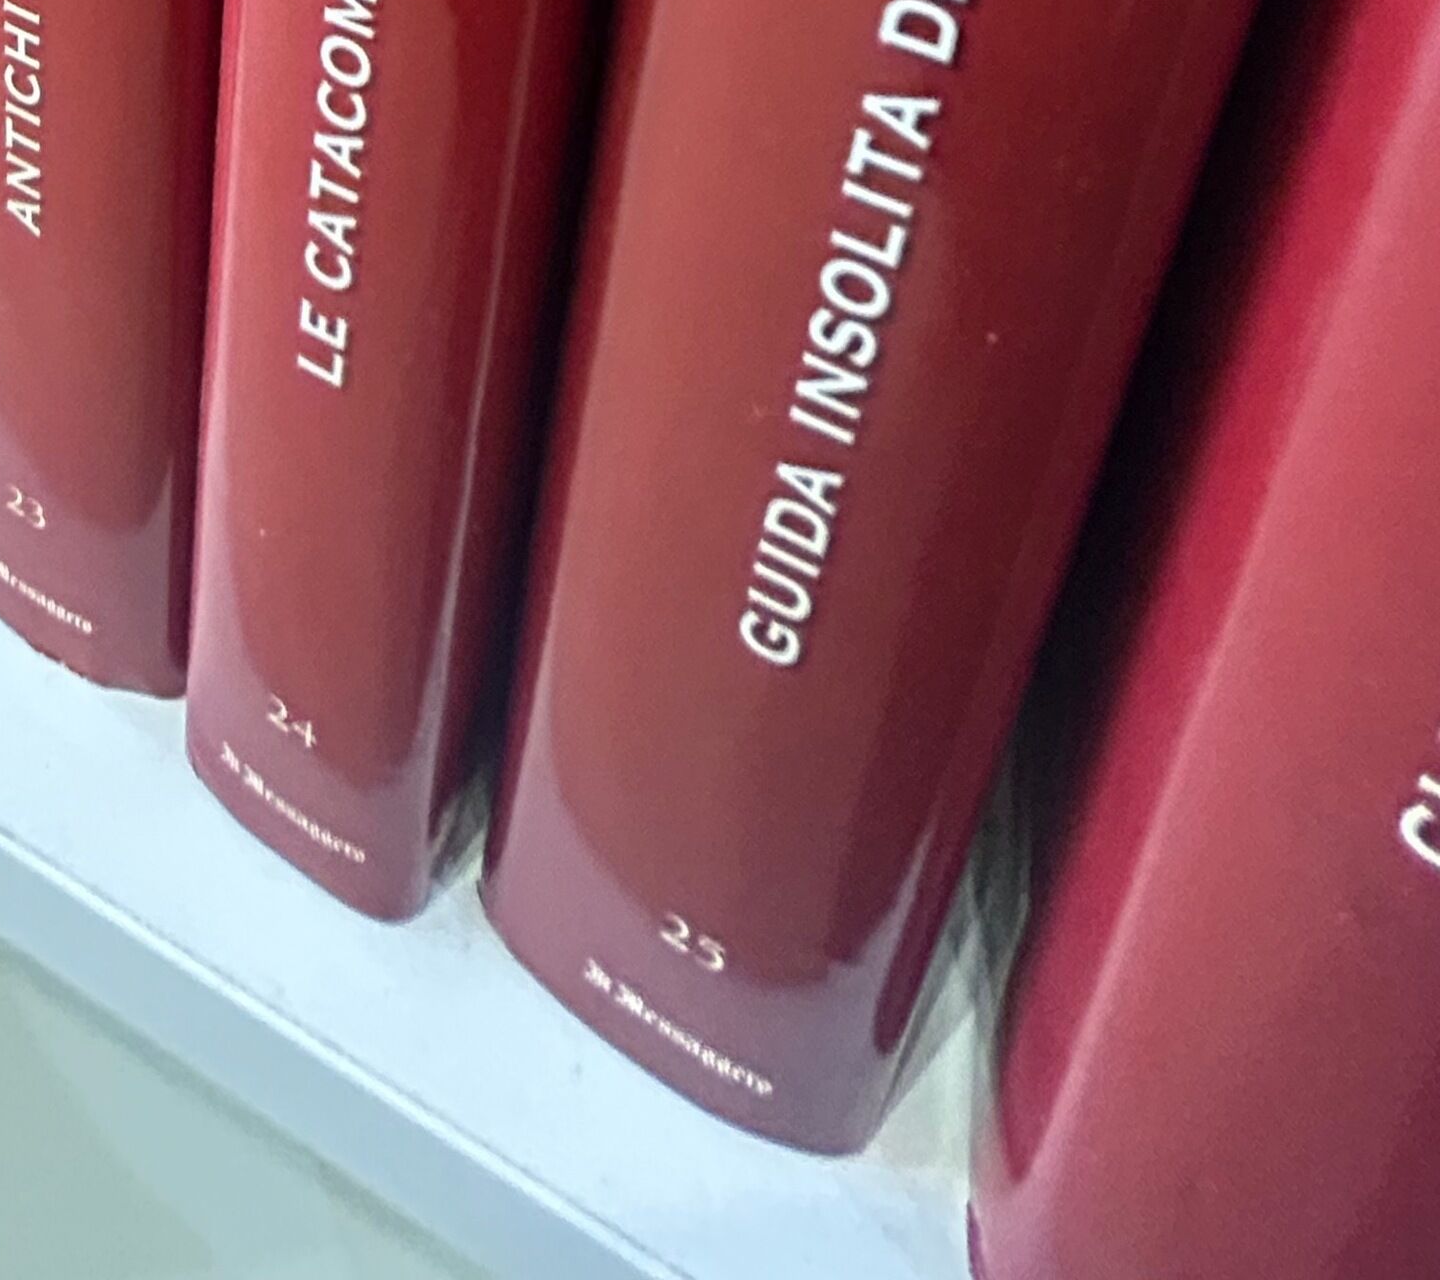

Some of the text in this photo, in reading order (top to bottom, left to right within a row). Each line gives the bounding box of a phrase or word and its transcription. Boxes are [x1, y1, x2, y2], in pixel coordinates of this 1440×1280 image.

[2, 0, 42, 238] ANTICHI
[788, 93, 942, 445] INSOLITA
[297, 296, 348, 388] LE
[6, 484, 47, 530] 23
[739, 460, 844, 668] GUIDA
[266, 691, 316, 749] 24
[660, 911, 726, 973] 25
